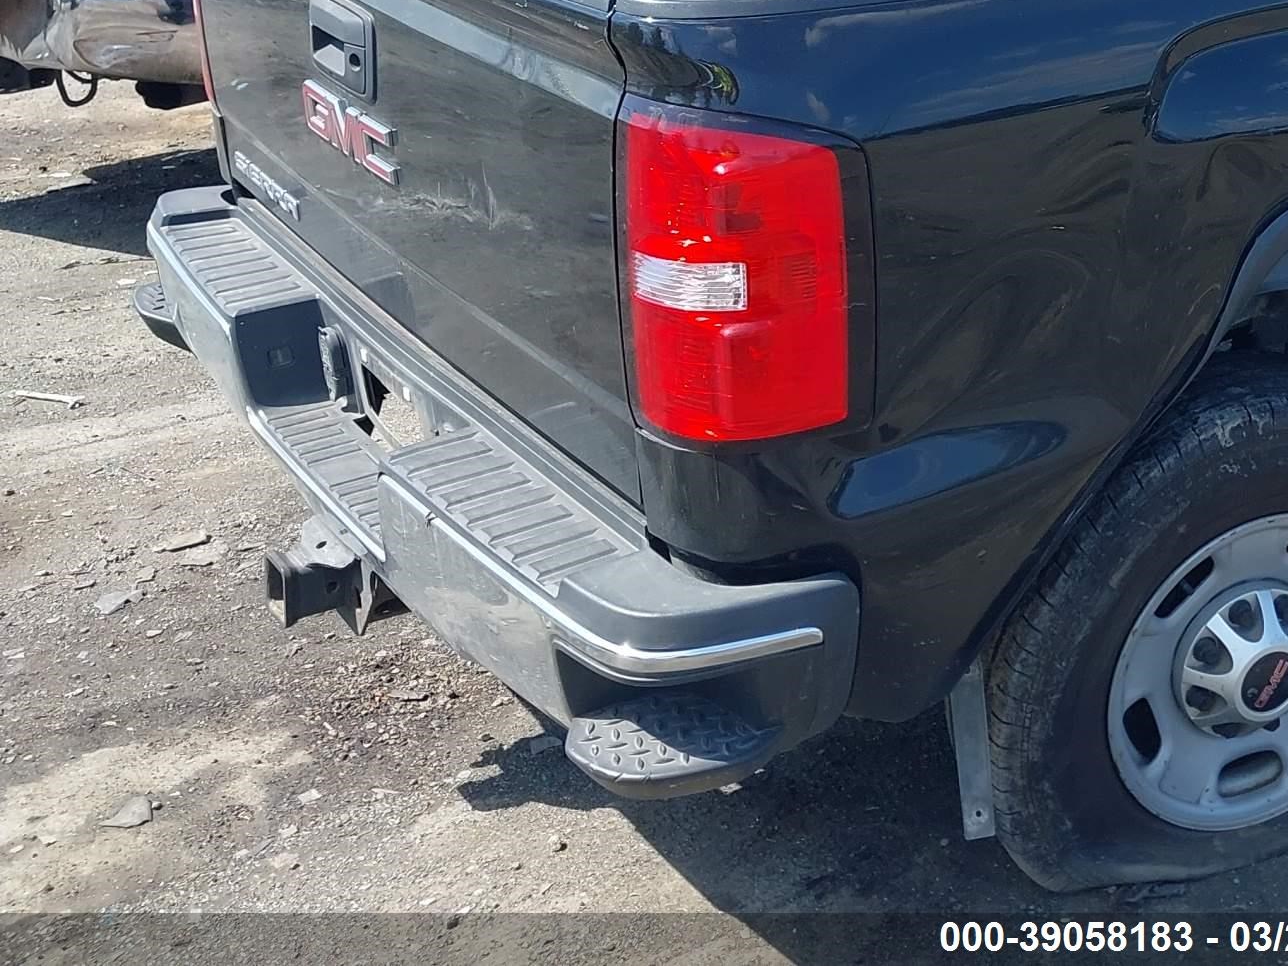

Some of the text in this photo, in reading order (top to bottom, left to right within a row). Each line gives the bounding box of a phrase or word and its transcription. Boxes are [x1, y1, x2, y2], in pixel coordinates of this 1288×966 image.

[302, 78, 401, 186] GMC
[233, 150, 301, 221] SIERRA
[1254, 659, 1288, 708] GMC
